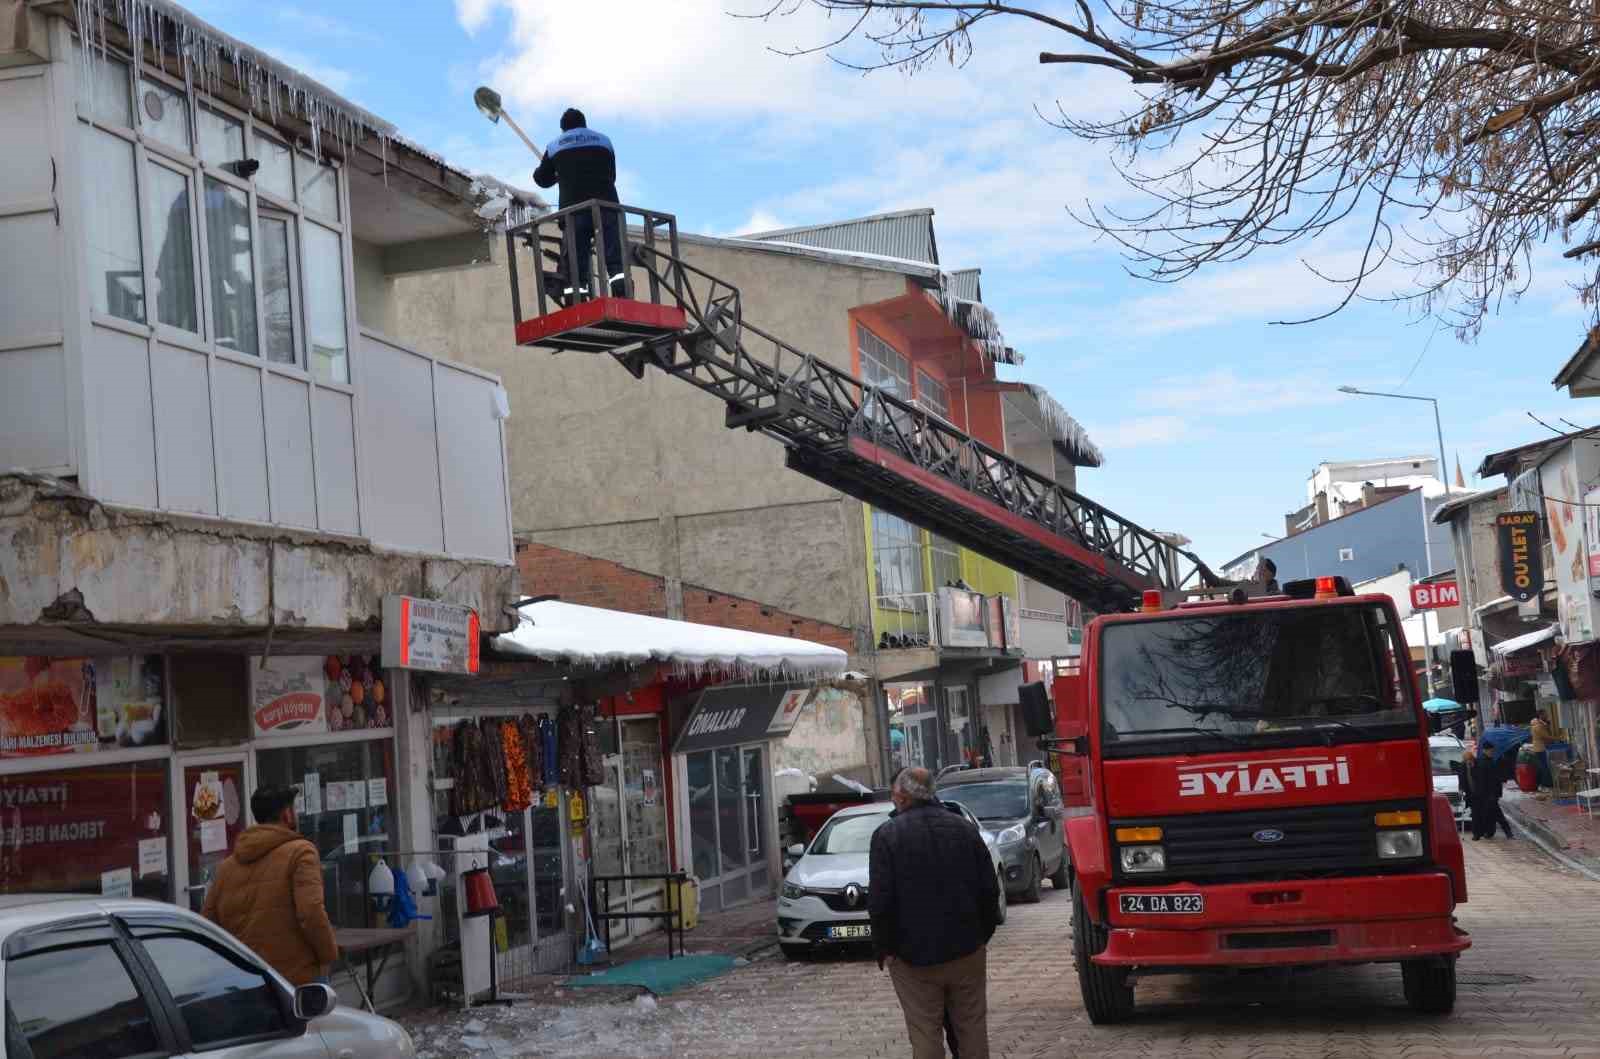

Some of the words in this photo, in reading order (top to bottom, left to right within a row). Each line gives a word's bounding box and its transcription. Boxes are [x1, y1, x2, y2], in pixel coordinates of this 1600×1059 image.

[1500, 514, 1535, 525] SARAY
[1512, 527, 1530, 588] OUTLET
[1416, 584, 1457, 605] BİM
[1127, 897, 1144, 911] 24
[1150, 897, 1169, 911] DA
[1174, 896, 1201, 911] 823
[832, 927, 843, 937] 34
